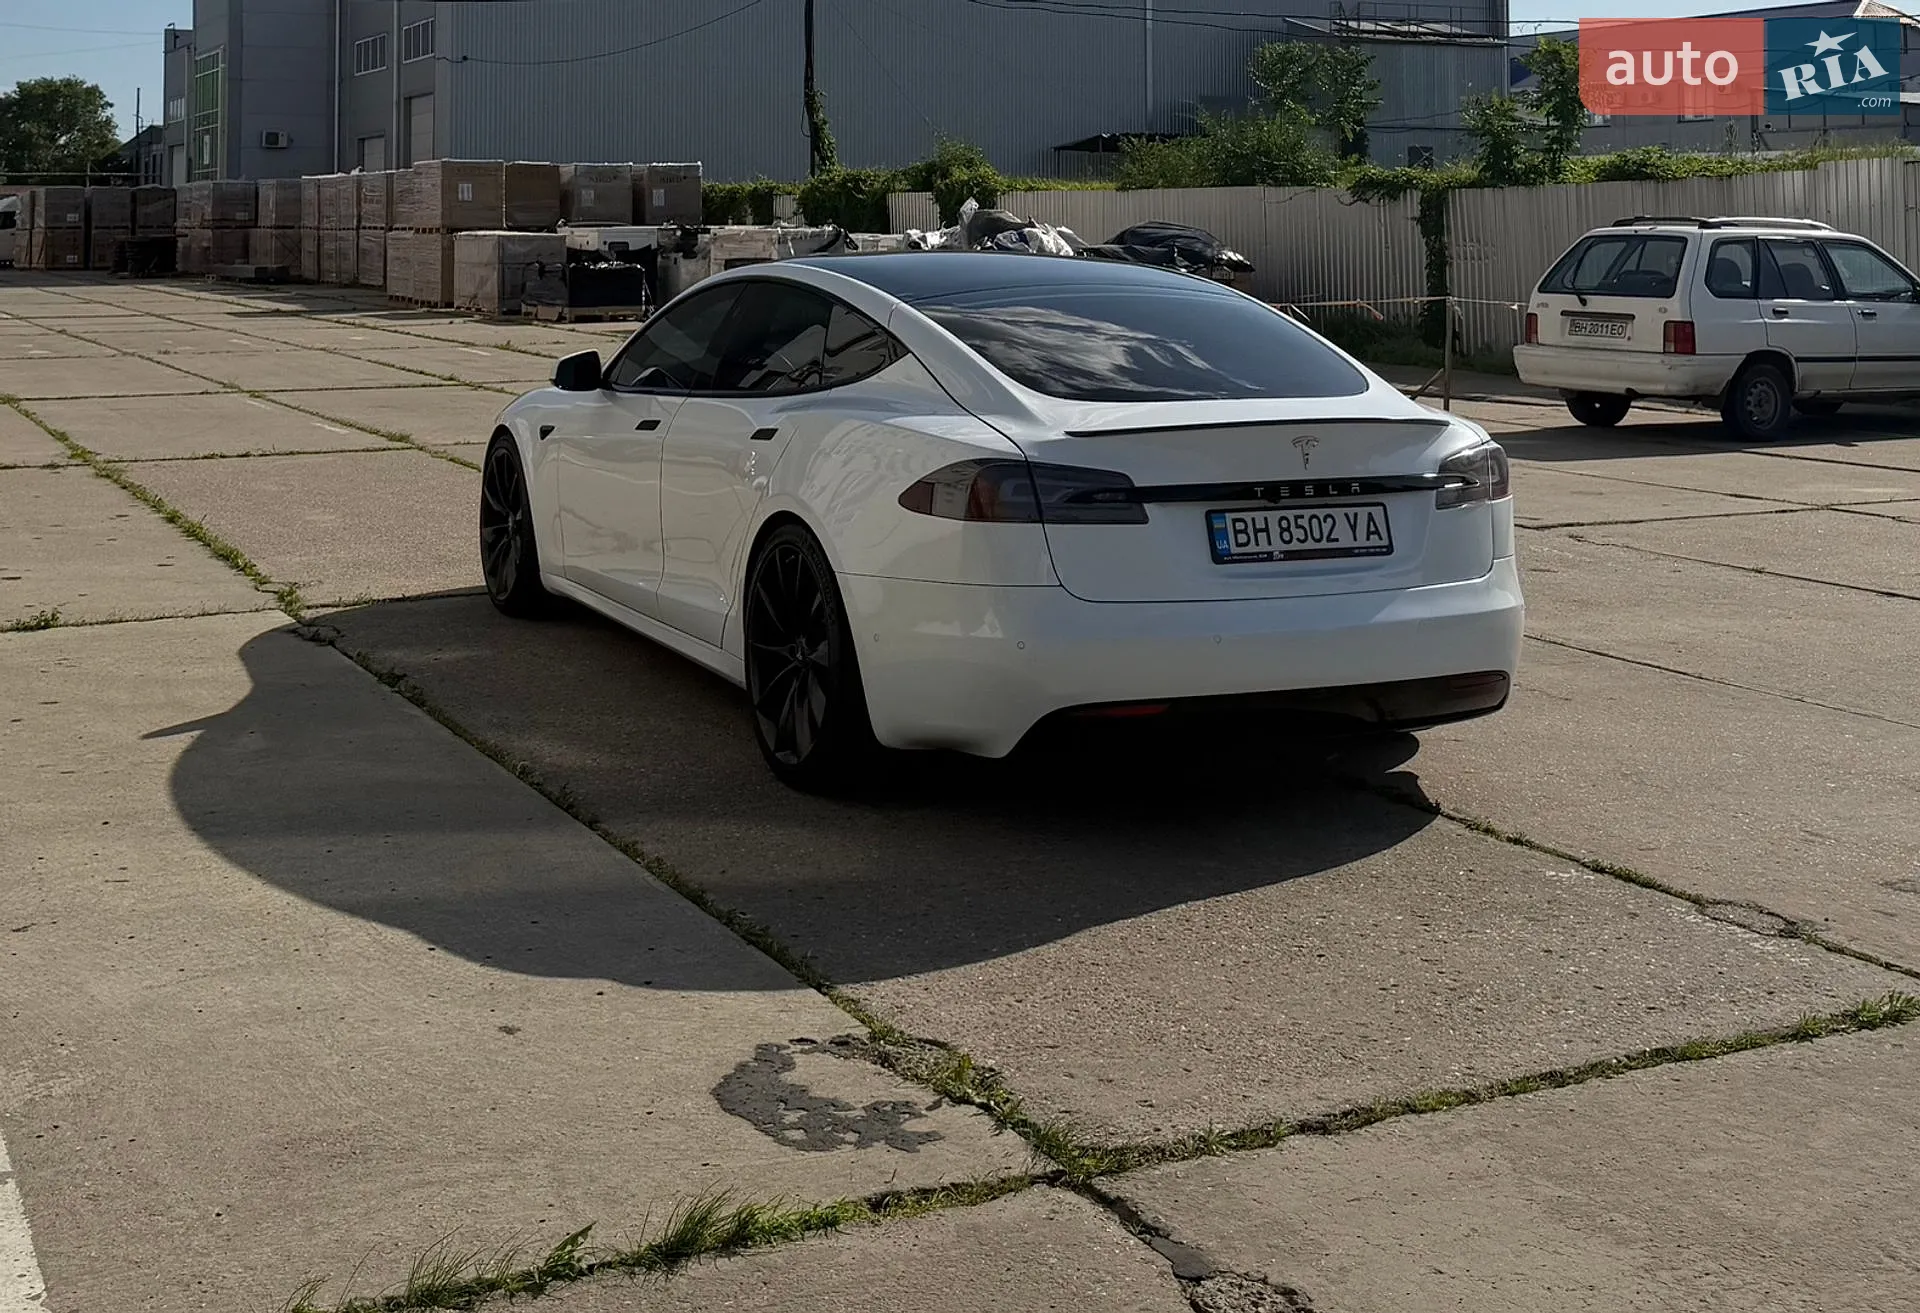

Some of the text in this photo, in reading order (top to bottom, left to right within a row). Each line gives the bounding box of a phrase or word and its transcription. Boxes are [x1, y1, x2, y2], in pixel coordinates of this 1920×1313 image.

[1254, 482, 1361, 498] TESLA
[1231, 511, 1384, 549] BH 8502 YA
